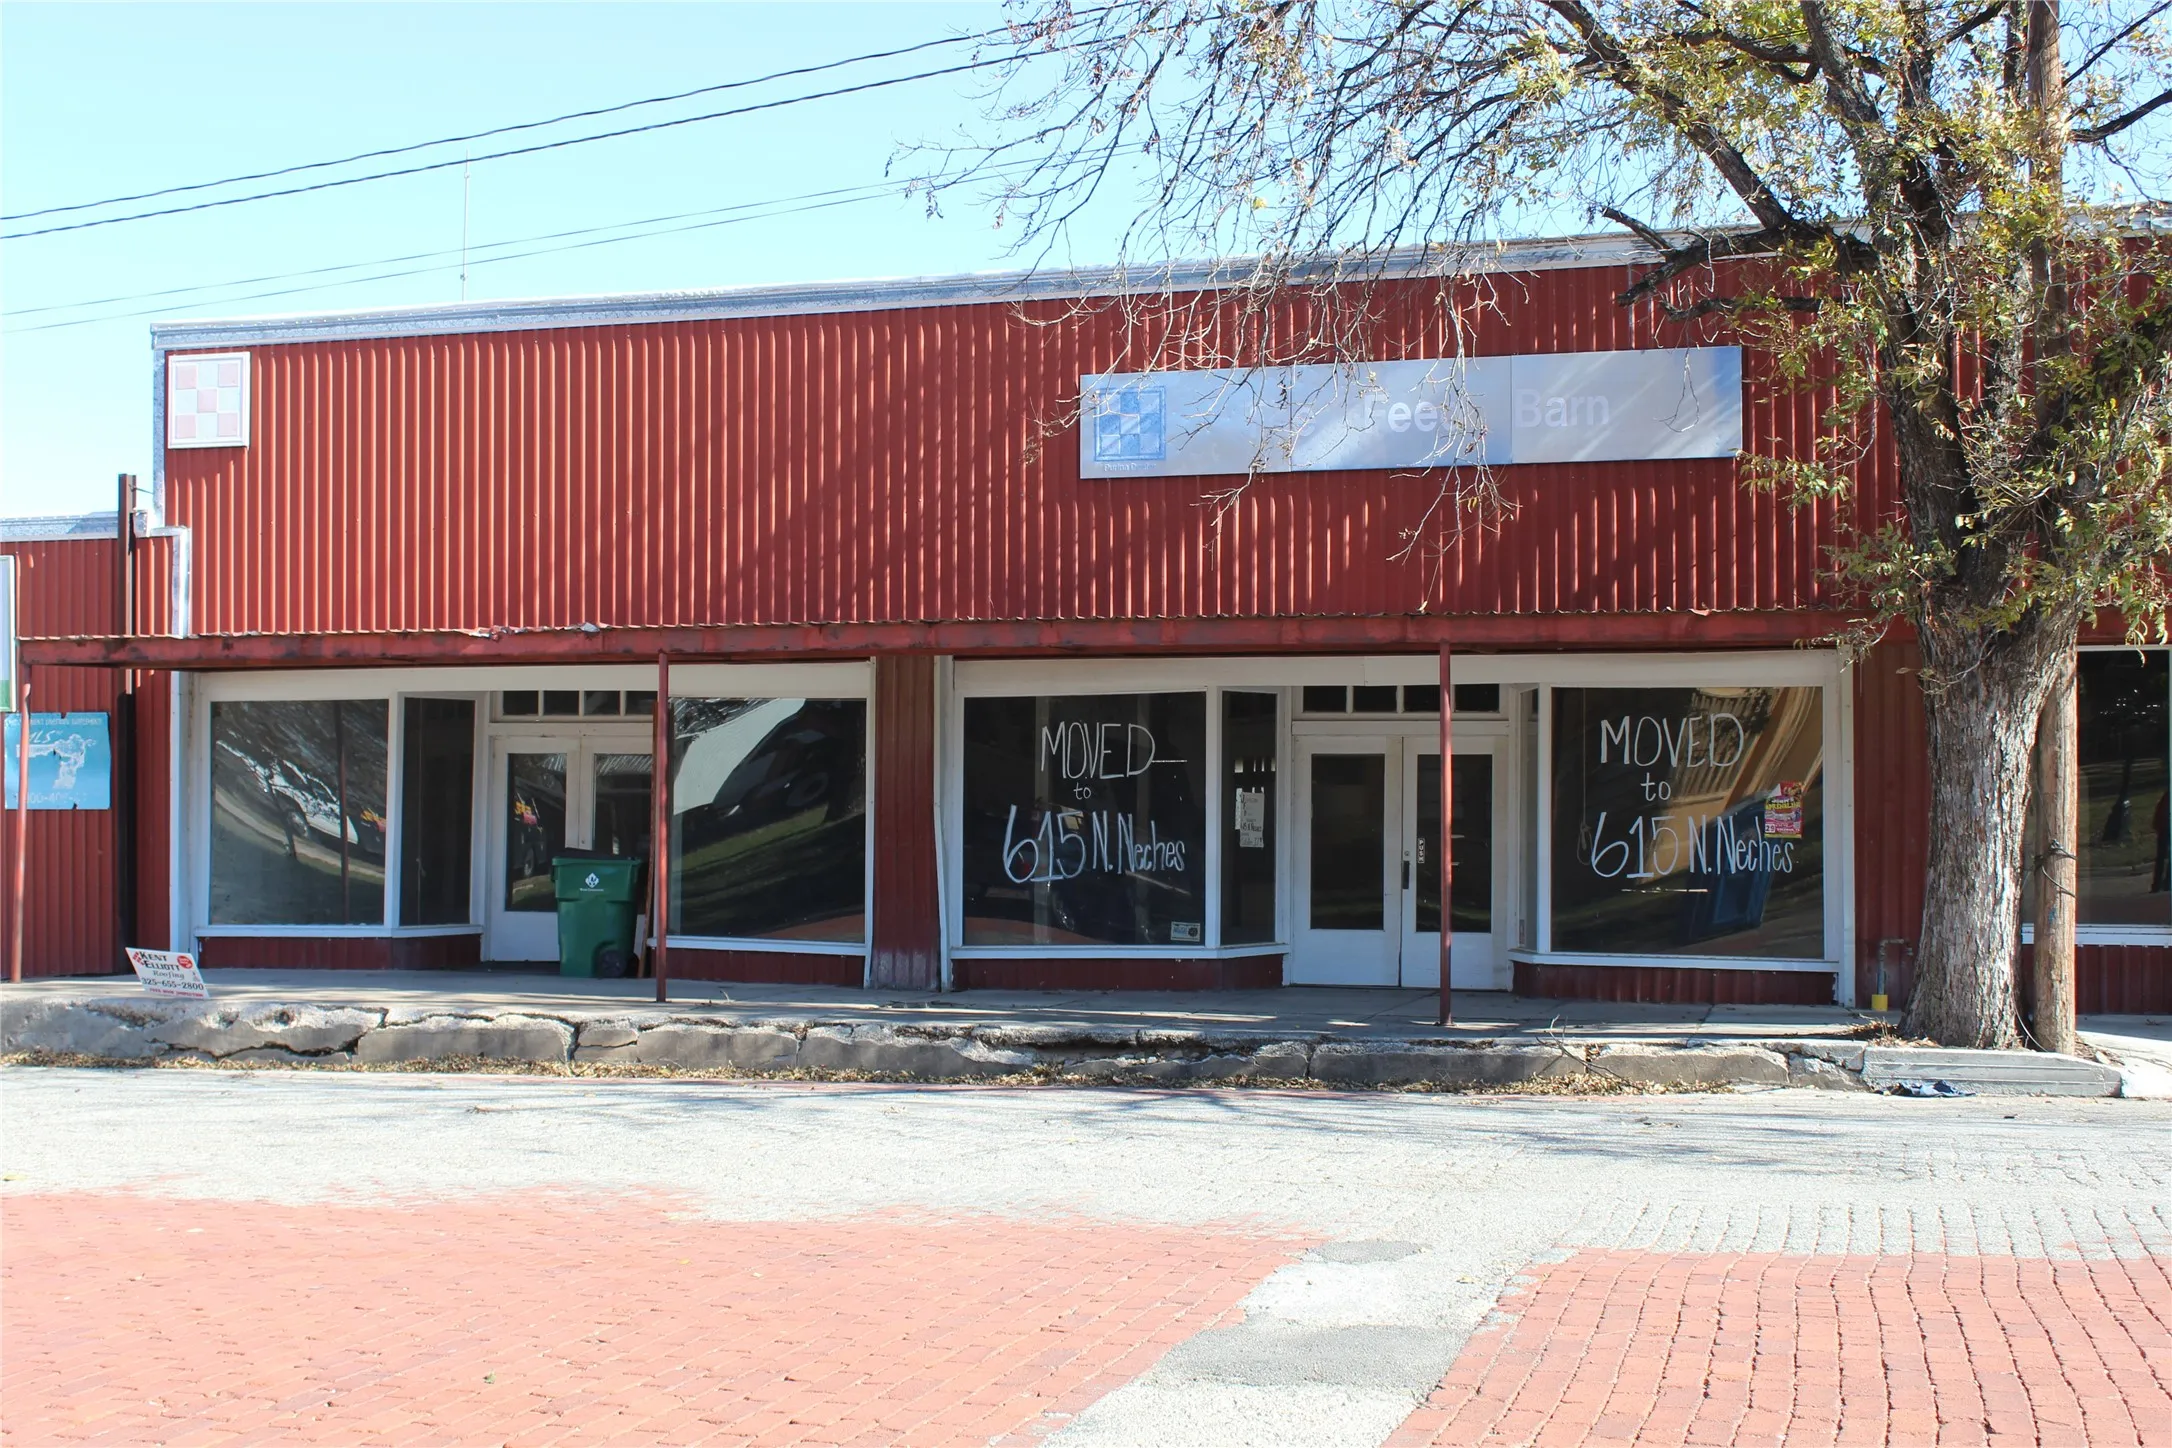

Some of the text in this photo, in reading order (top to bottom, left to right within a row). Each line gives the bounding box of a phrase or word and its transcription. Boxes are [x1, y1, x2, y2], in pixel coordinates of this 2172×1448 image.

[1514, 388, 1609, 428] Barn
[1041, 721, 1156, 779] MOVED
[1600, 712, 1745, 768] MOVED
[1073, 782, 1092, 800] to
[1640, 772, 1672, 801] to
[1003, 804, 1087, 884] 615
[1092, 810, 1114, 873] N.
[1117, 812, 1186, 875] Neches
[1591, 811, 1795, 879] 615 N. Neches
[141, 977, 204, 991] 325-655-2800
[152, 969, 185, 980] Roofing
